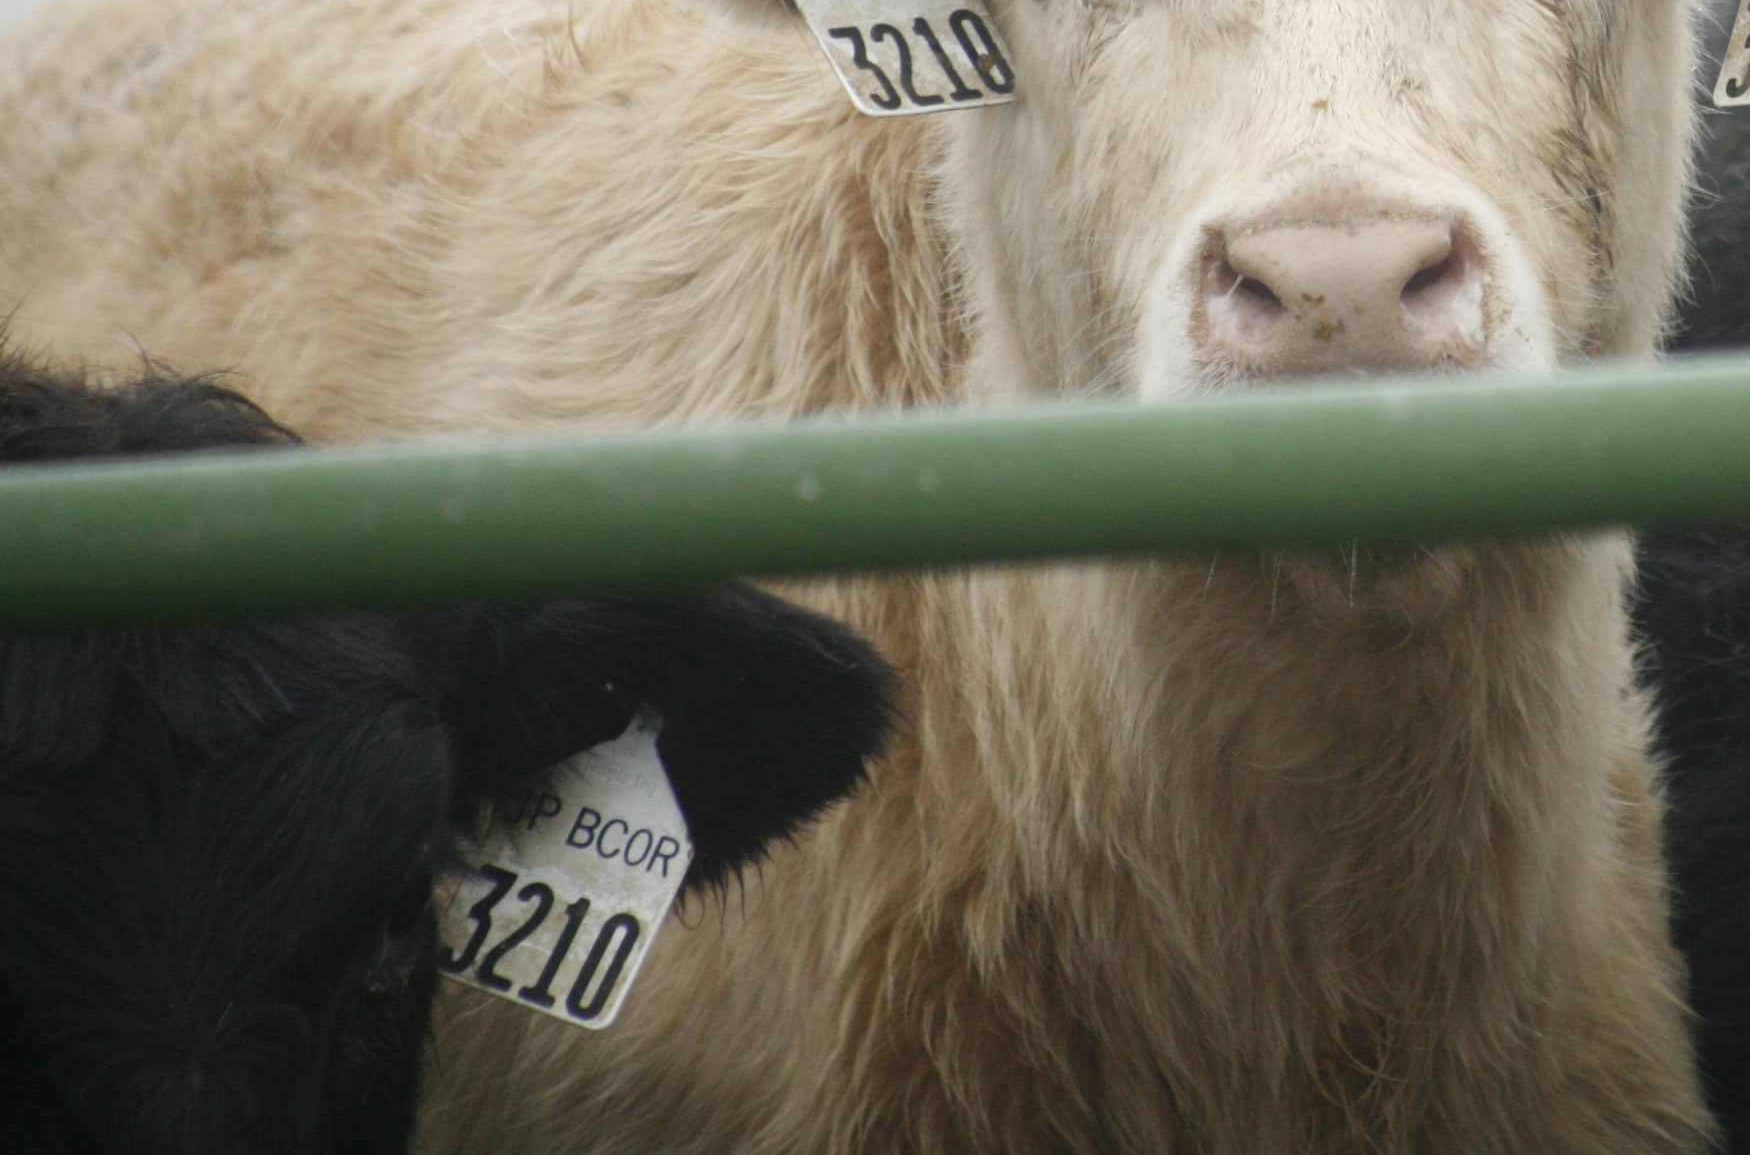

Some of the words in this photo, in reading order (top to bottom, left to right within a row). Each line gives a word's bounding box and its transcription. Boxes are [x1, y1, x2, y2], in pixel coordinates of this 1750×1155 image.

[828, 9, 1015, 109] 3210
[565, 806, 681, 878] BCOR
[438, 863, 641, 1022] 3210
